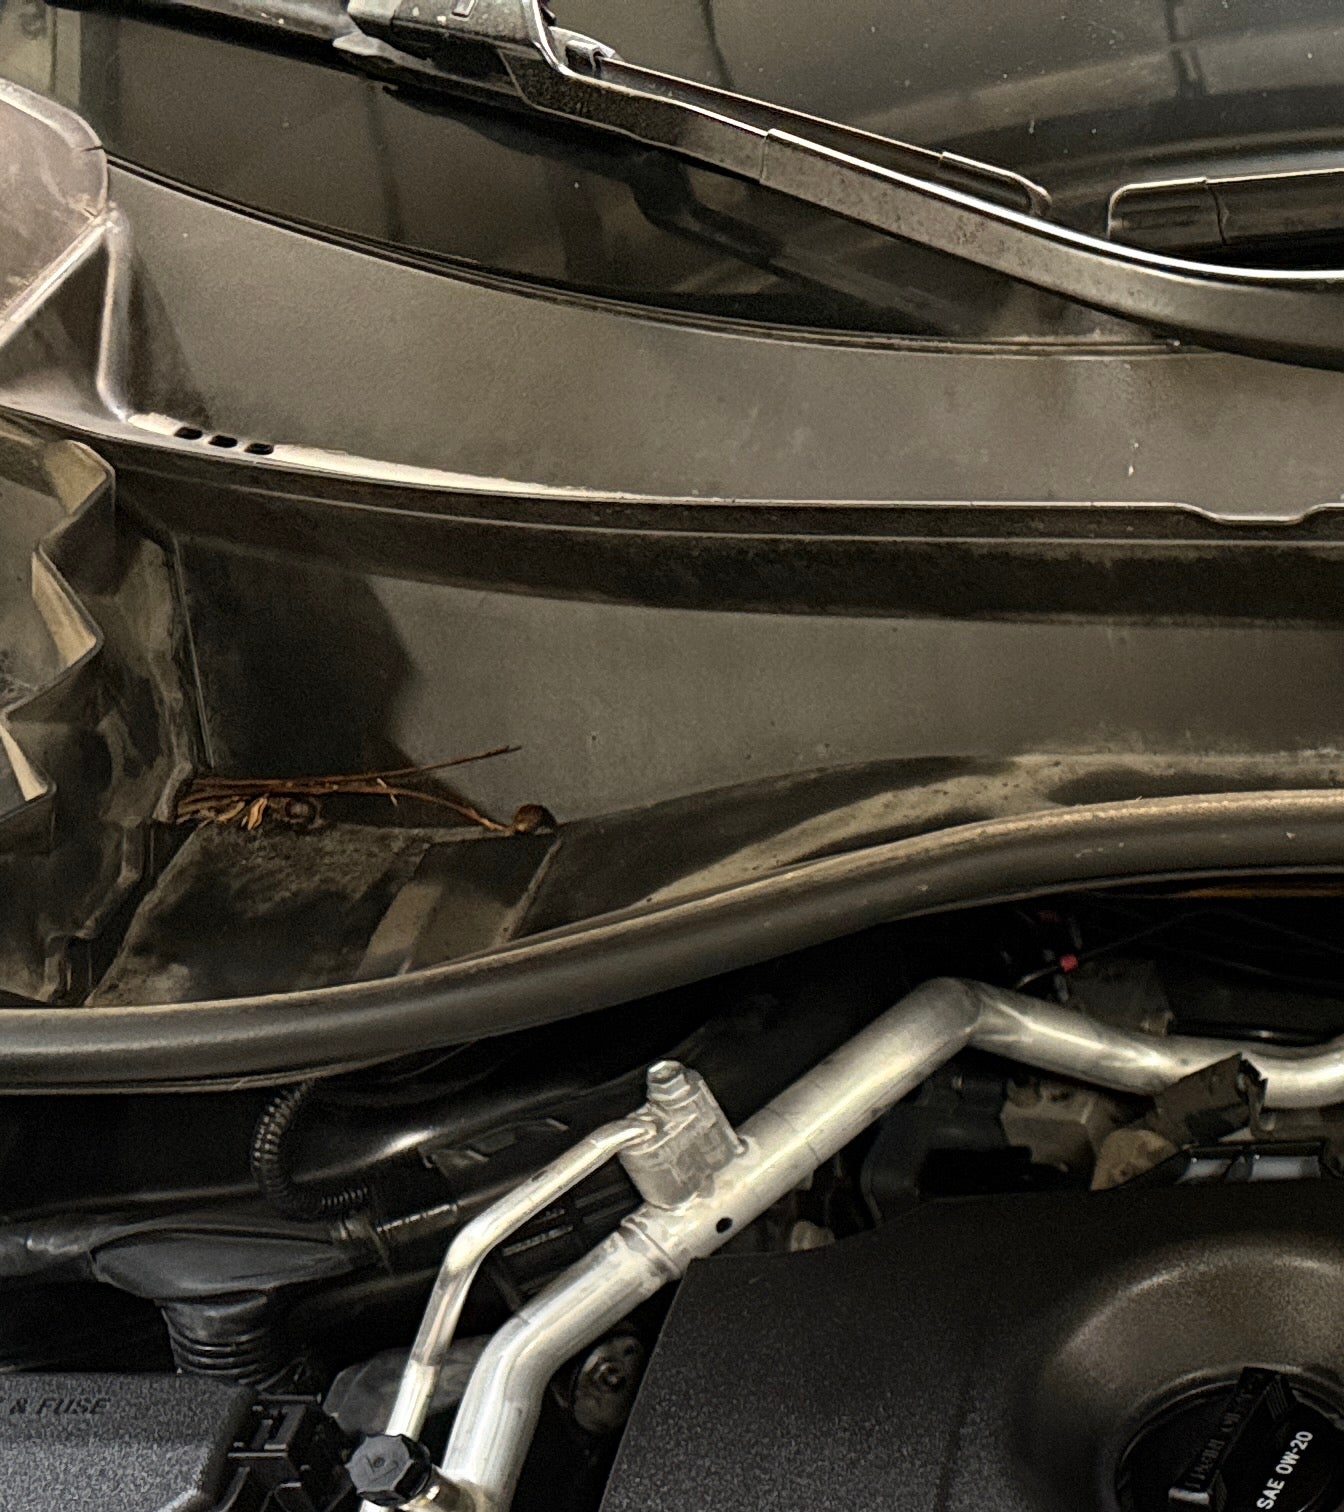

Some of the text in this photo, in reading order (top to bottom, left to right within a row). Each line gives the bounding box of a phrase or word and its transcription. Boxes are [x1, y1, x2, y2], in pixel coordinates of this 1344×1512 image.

[35, 1397, 111, 1415] FUSE
[1256, 1430, 1314, 1511] SAE 0W-20
